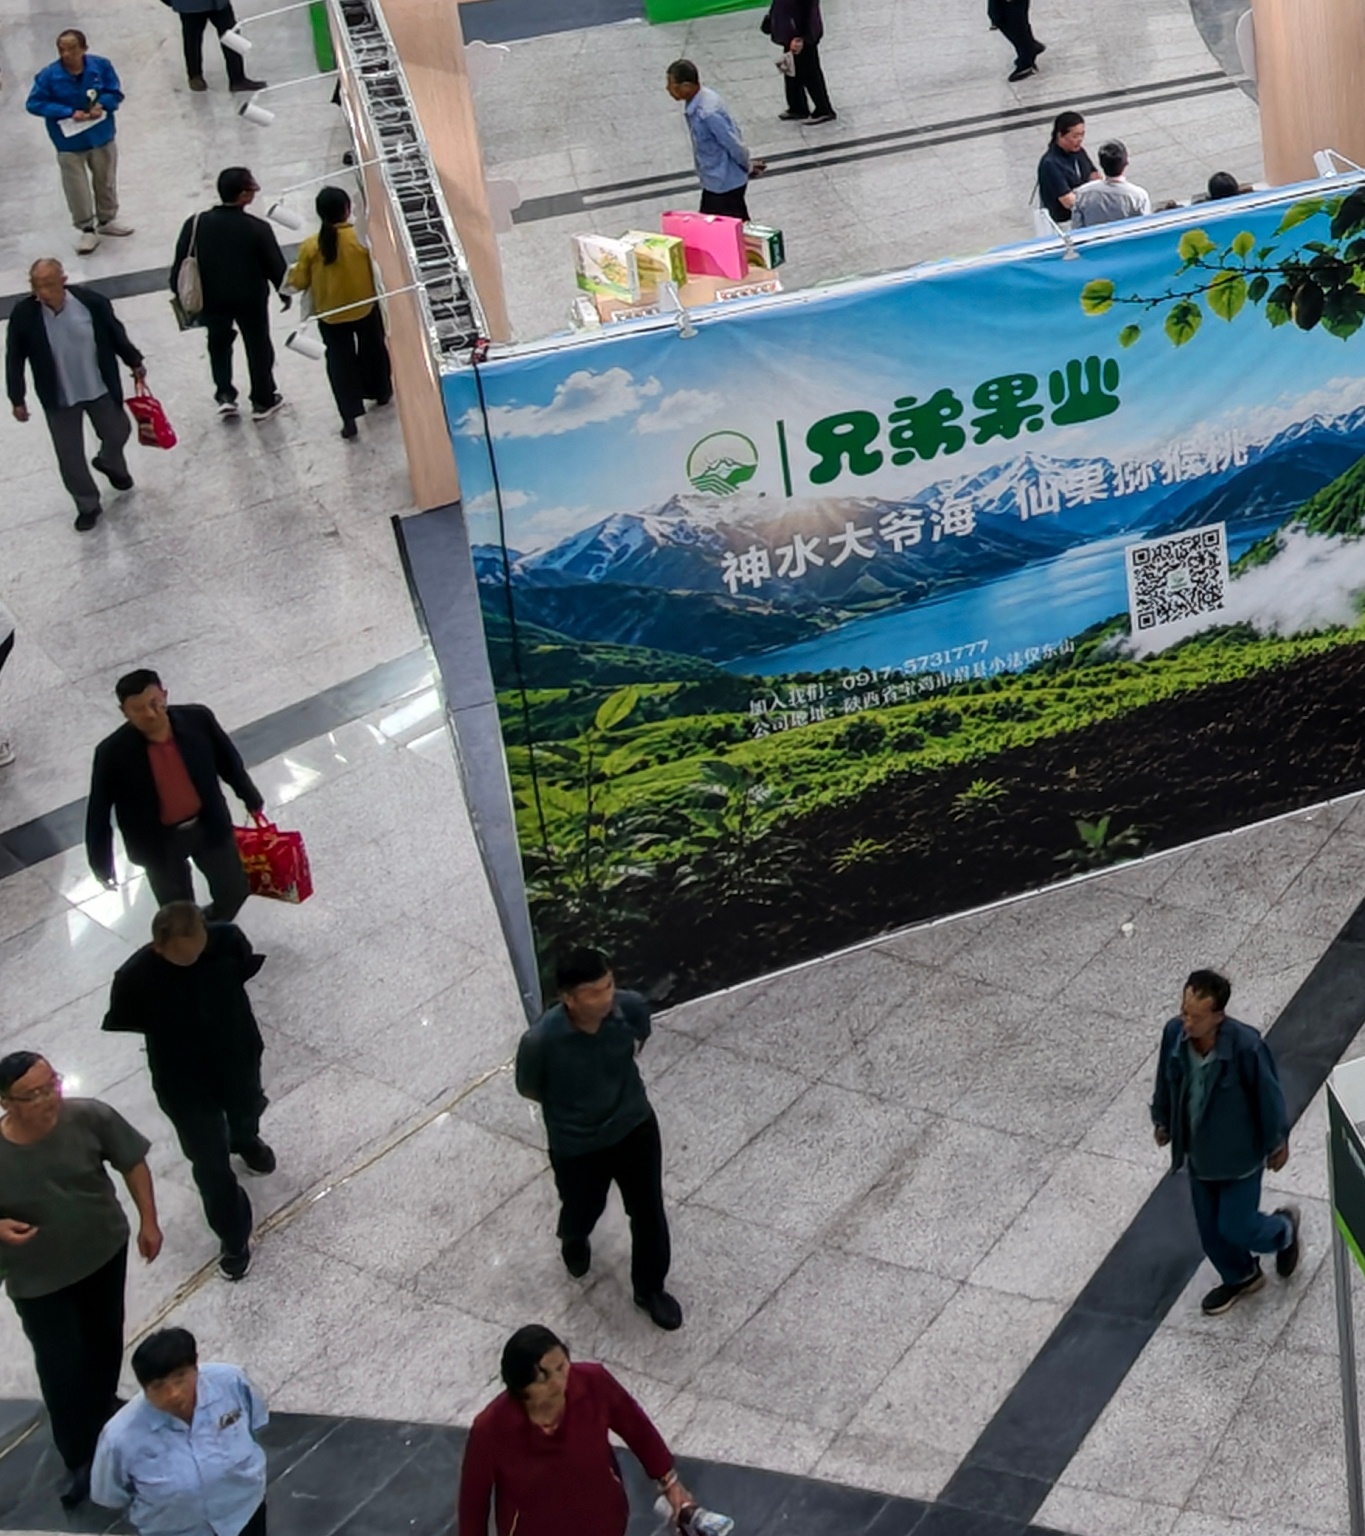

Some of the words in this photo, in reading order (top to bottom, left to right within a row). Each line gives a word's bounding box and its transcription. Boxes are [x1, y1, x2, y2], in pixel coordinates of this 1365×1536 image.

[805, 355, 1121, 485] 兄弟果业
[721, 491, 978, 593] 神水大爷海
[1016, 427, 1250, 522] 仙果猕猴桃
